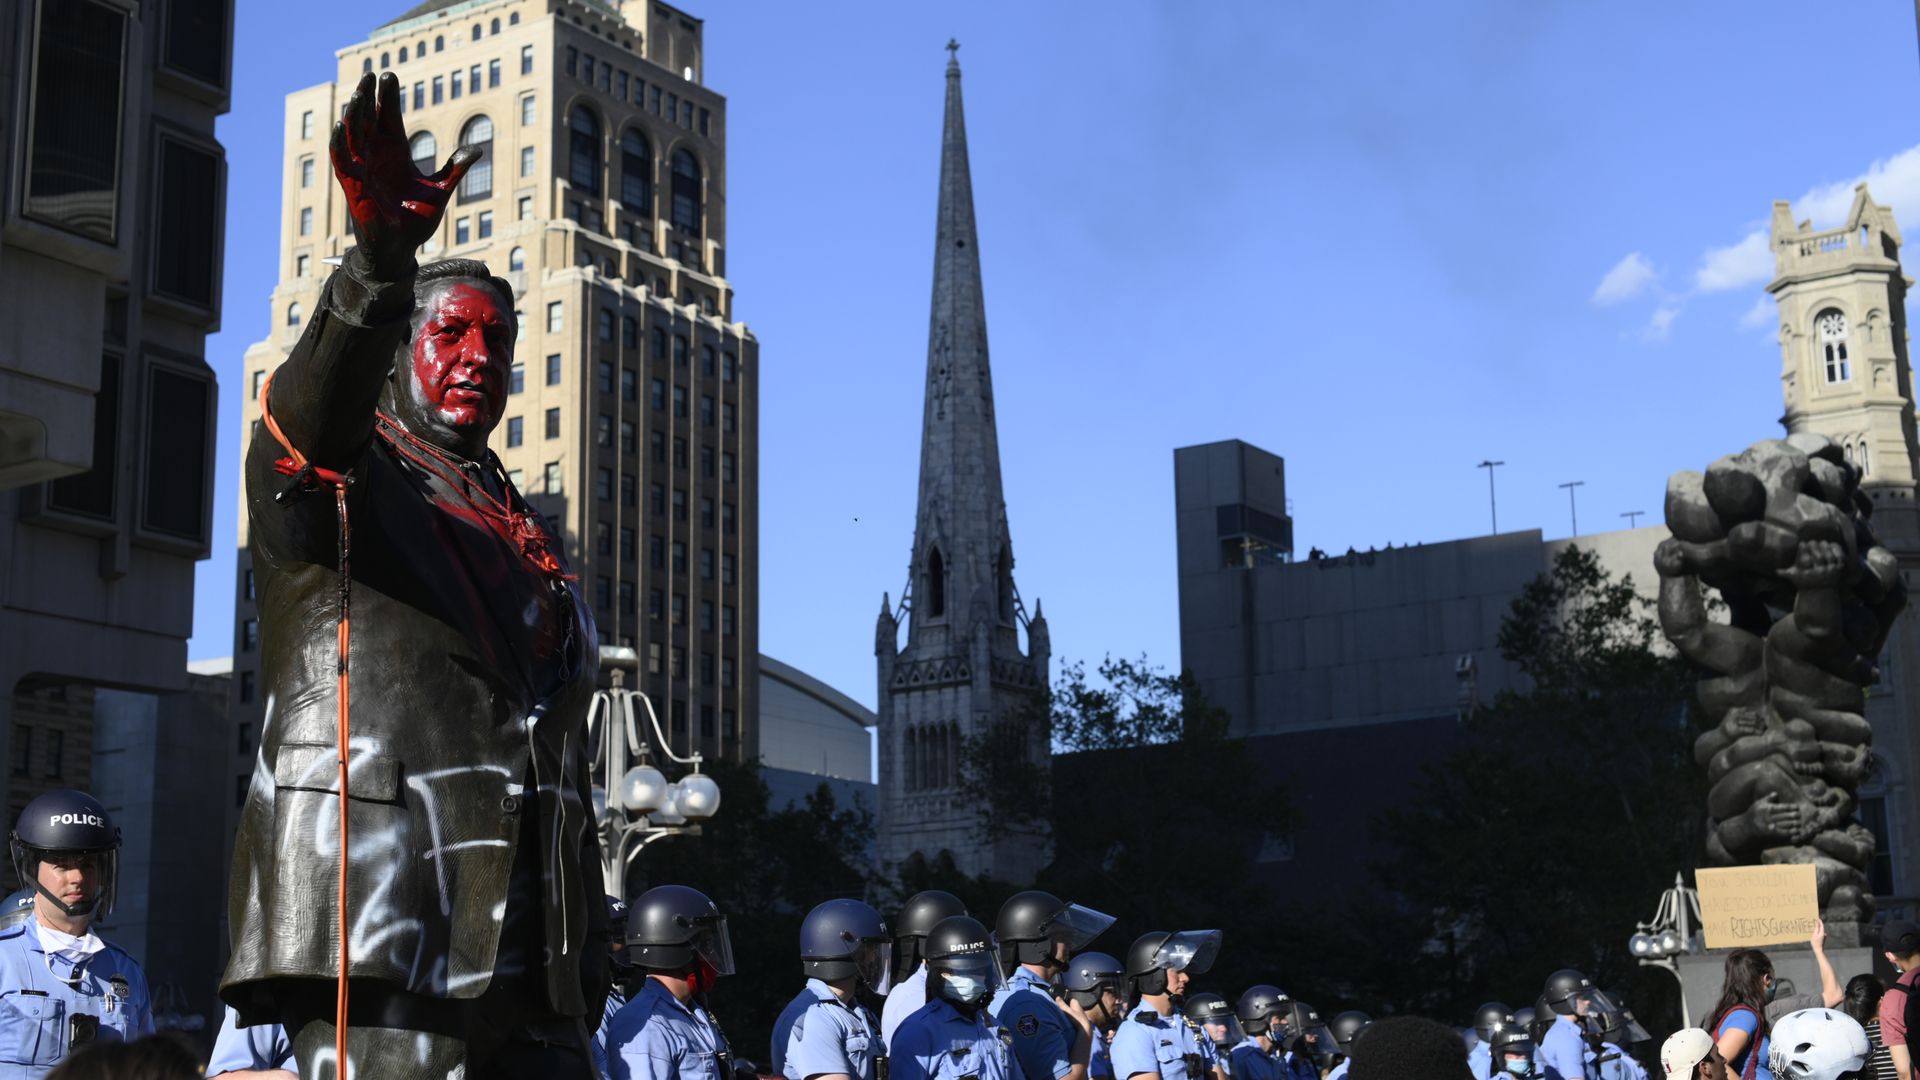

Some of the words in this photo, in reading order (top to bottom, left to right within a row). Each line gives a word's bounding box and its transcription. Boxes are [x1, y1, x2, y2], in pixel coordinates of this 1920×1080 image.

[50, 813, 104, 828] POLICE
[1730, 916, 1769, 939] RIGHTS
[950, 941, 984, 955] POLICE
